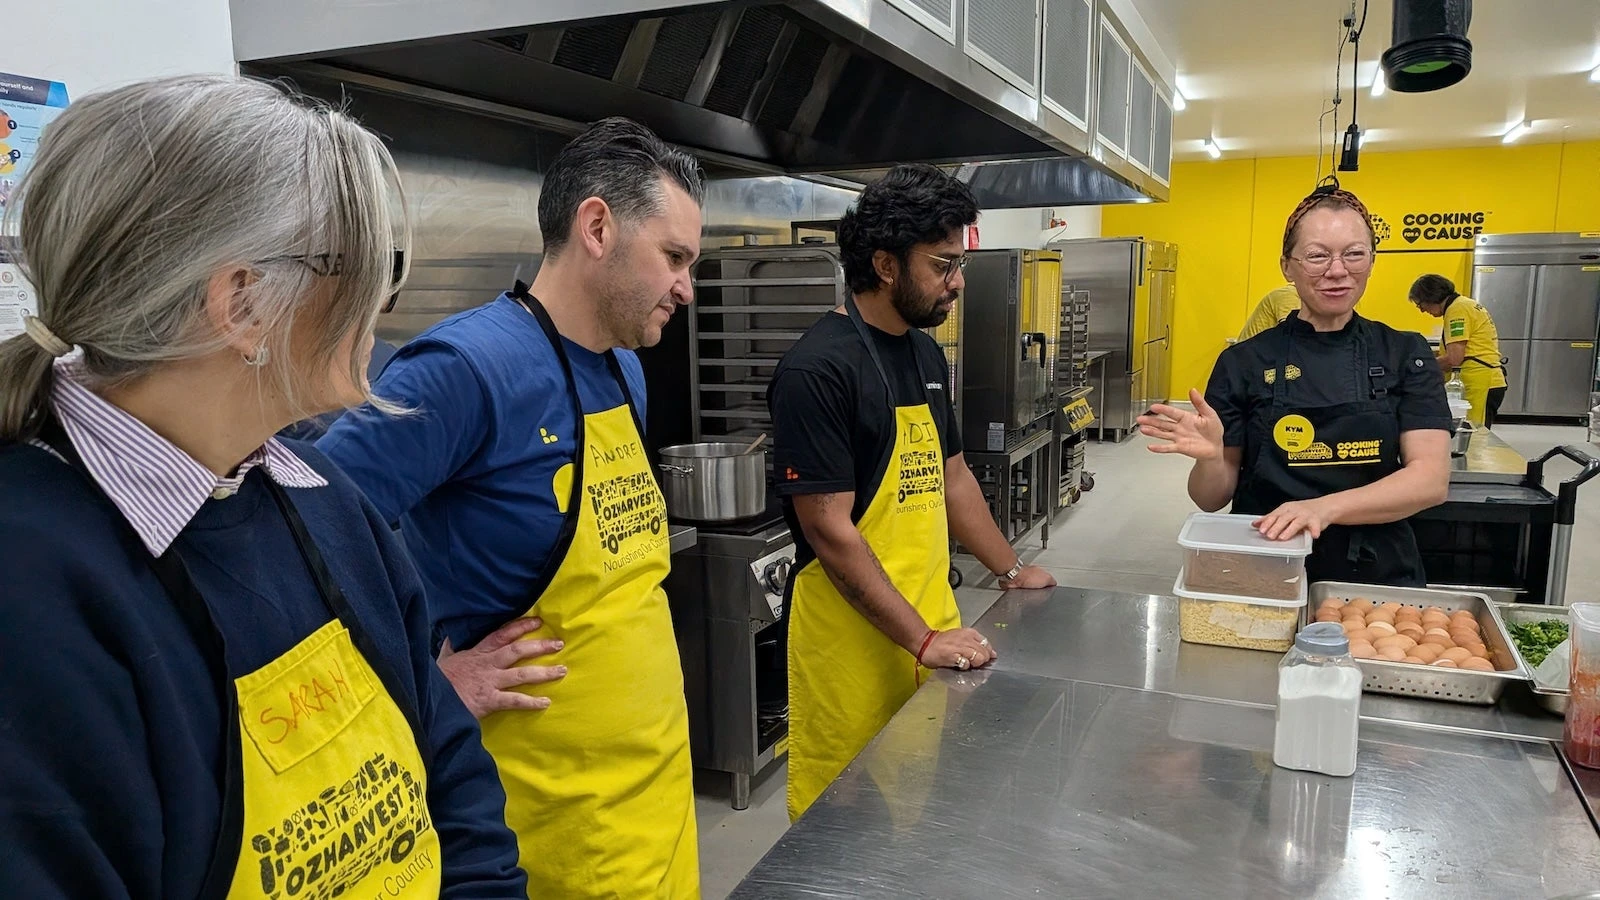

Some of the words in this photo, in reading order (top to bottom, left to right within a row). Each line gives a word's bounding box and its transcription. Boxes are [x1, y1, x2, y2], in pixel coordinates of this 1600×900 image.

[1403, 212, 1484, 226] COOKING
[1423, 226, 1483, 240] CAUSE
[1337, 440, 1380, 450] COOKING
[1349, 448, 1380, 457] CAUSE
[603, 490, 656, 521] OZHARVEST
[603, 548, 646, 574] Nourishing
[260, 658, 351, 745] SARAH
[286, 783, 404, 897] OZHARVEST
[383, 847, 434, 896] Country
